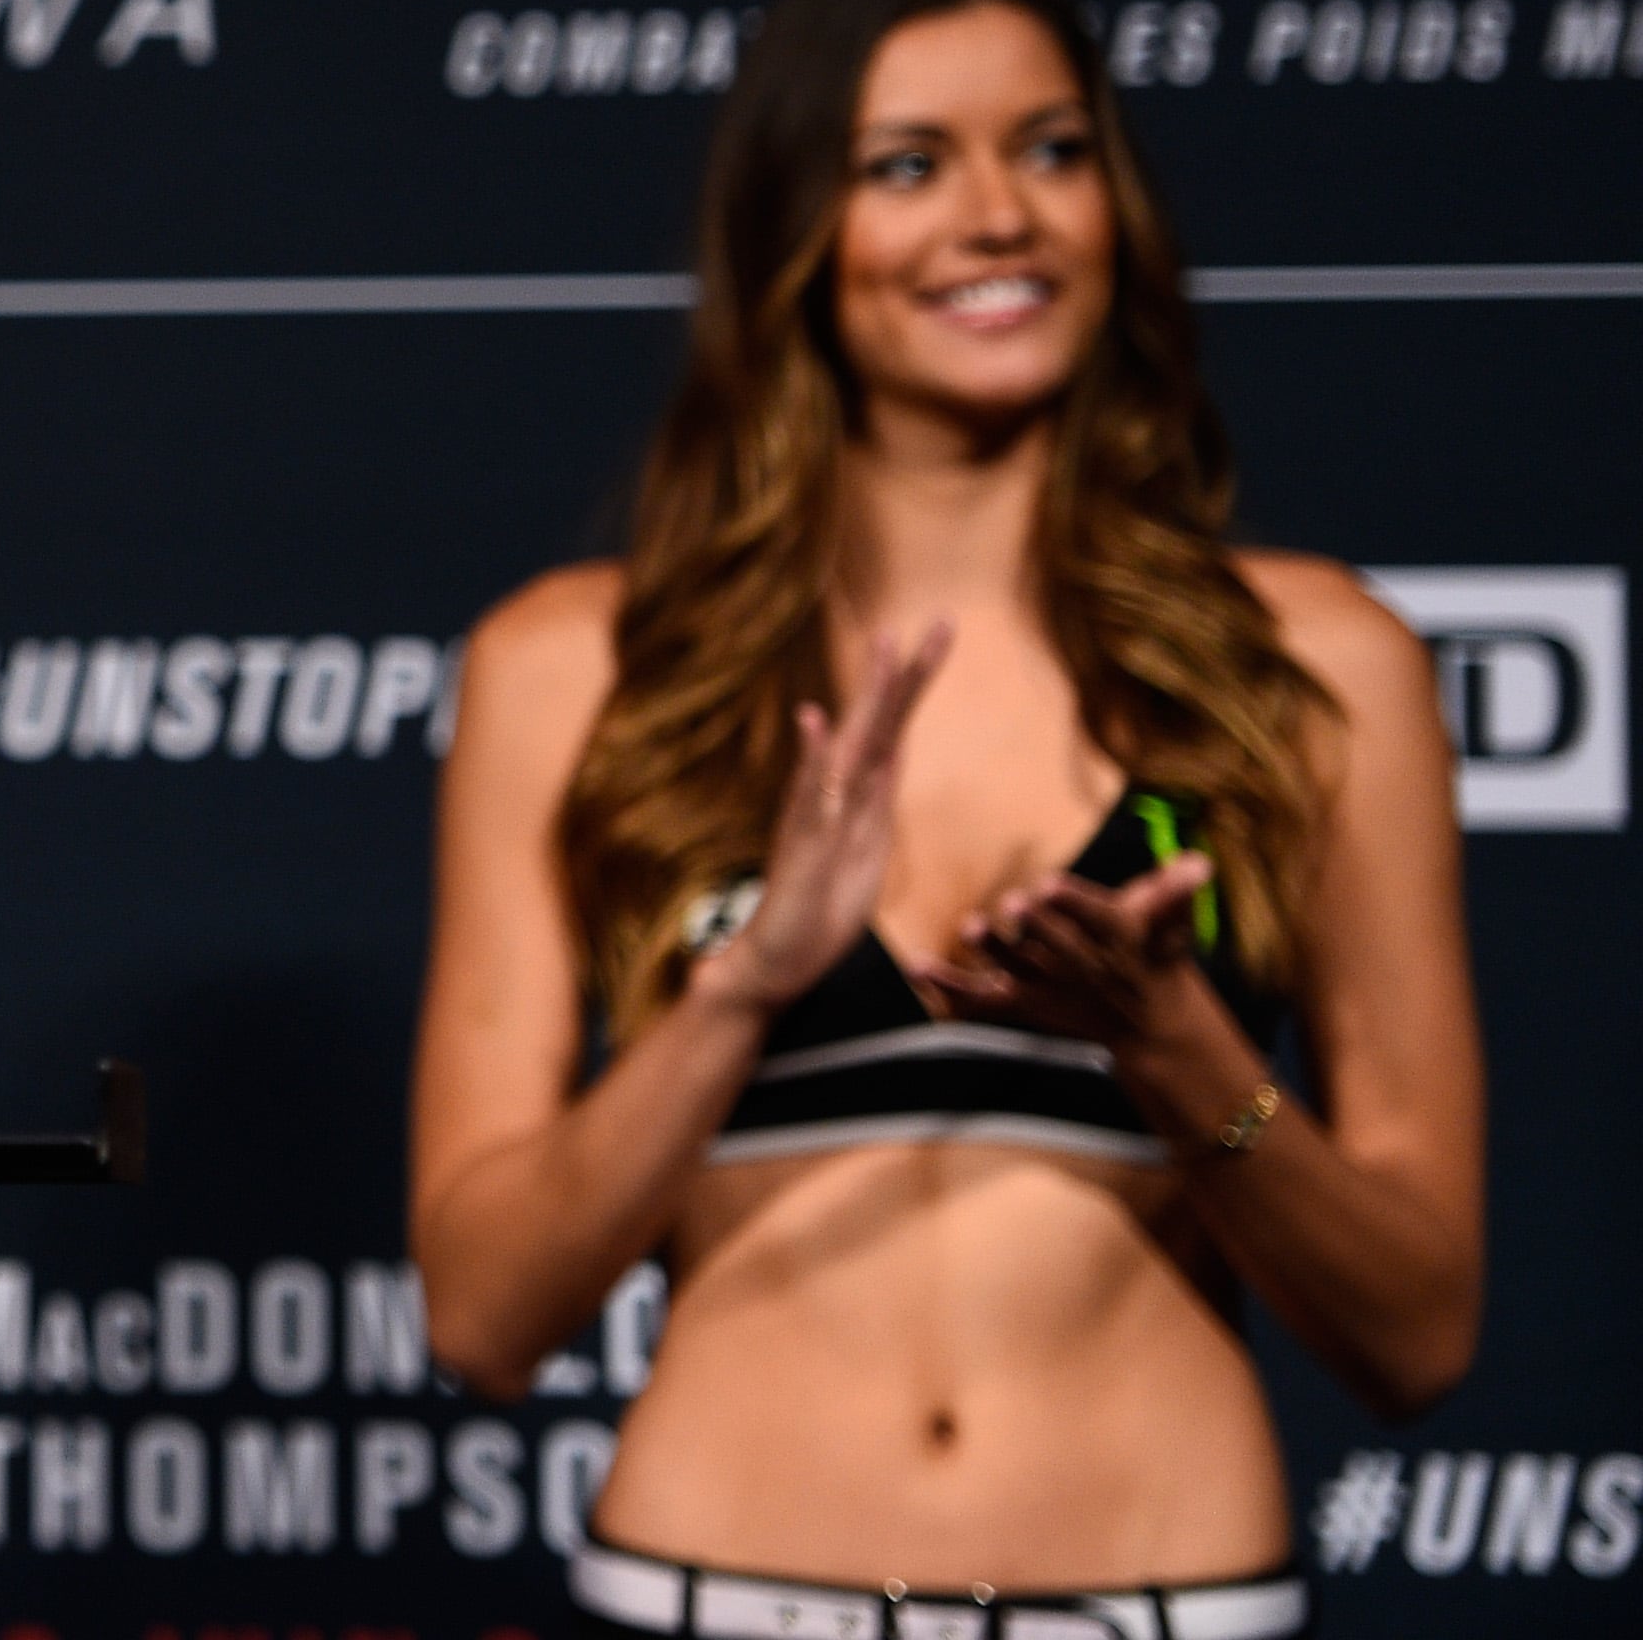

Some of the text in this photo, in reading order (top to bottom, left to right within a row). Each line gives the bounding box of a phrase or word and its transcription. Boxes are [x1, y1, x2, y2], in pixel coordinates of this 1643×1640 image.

[447, 8, 760, 98] COMBA
[1083, 0, 1220, 87] ES
[1312, 1449, 1643, 1576] #UNS
